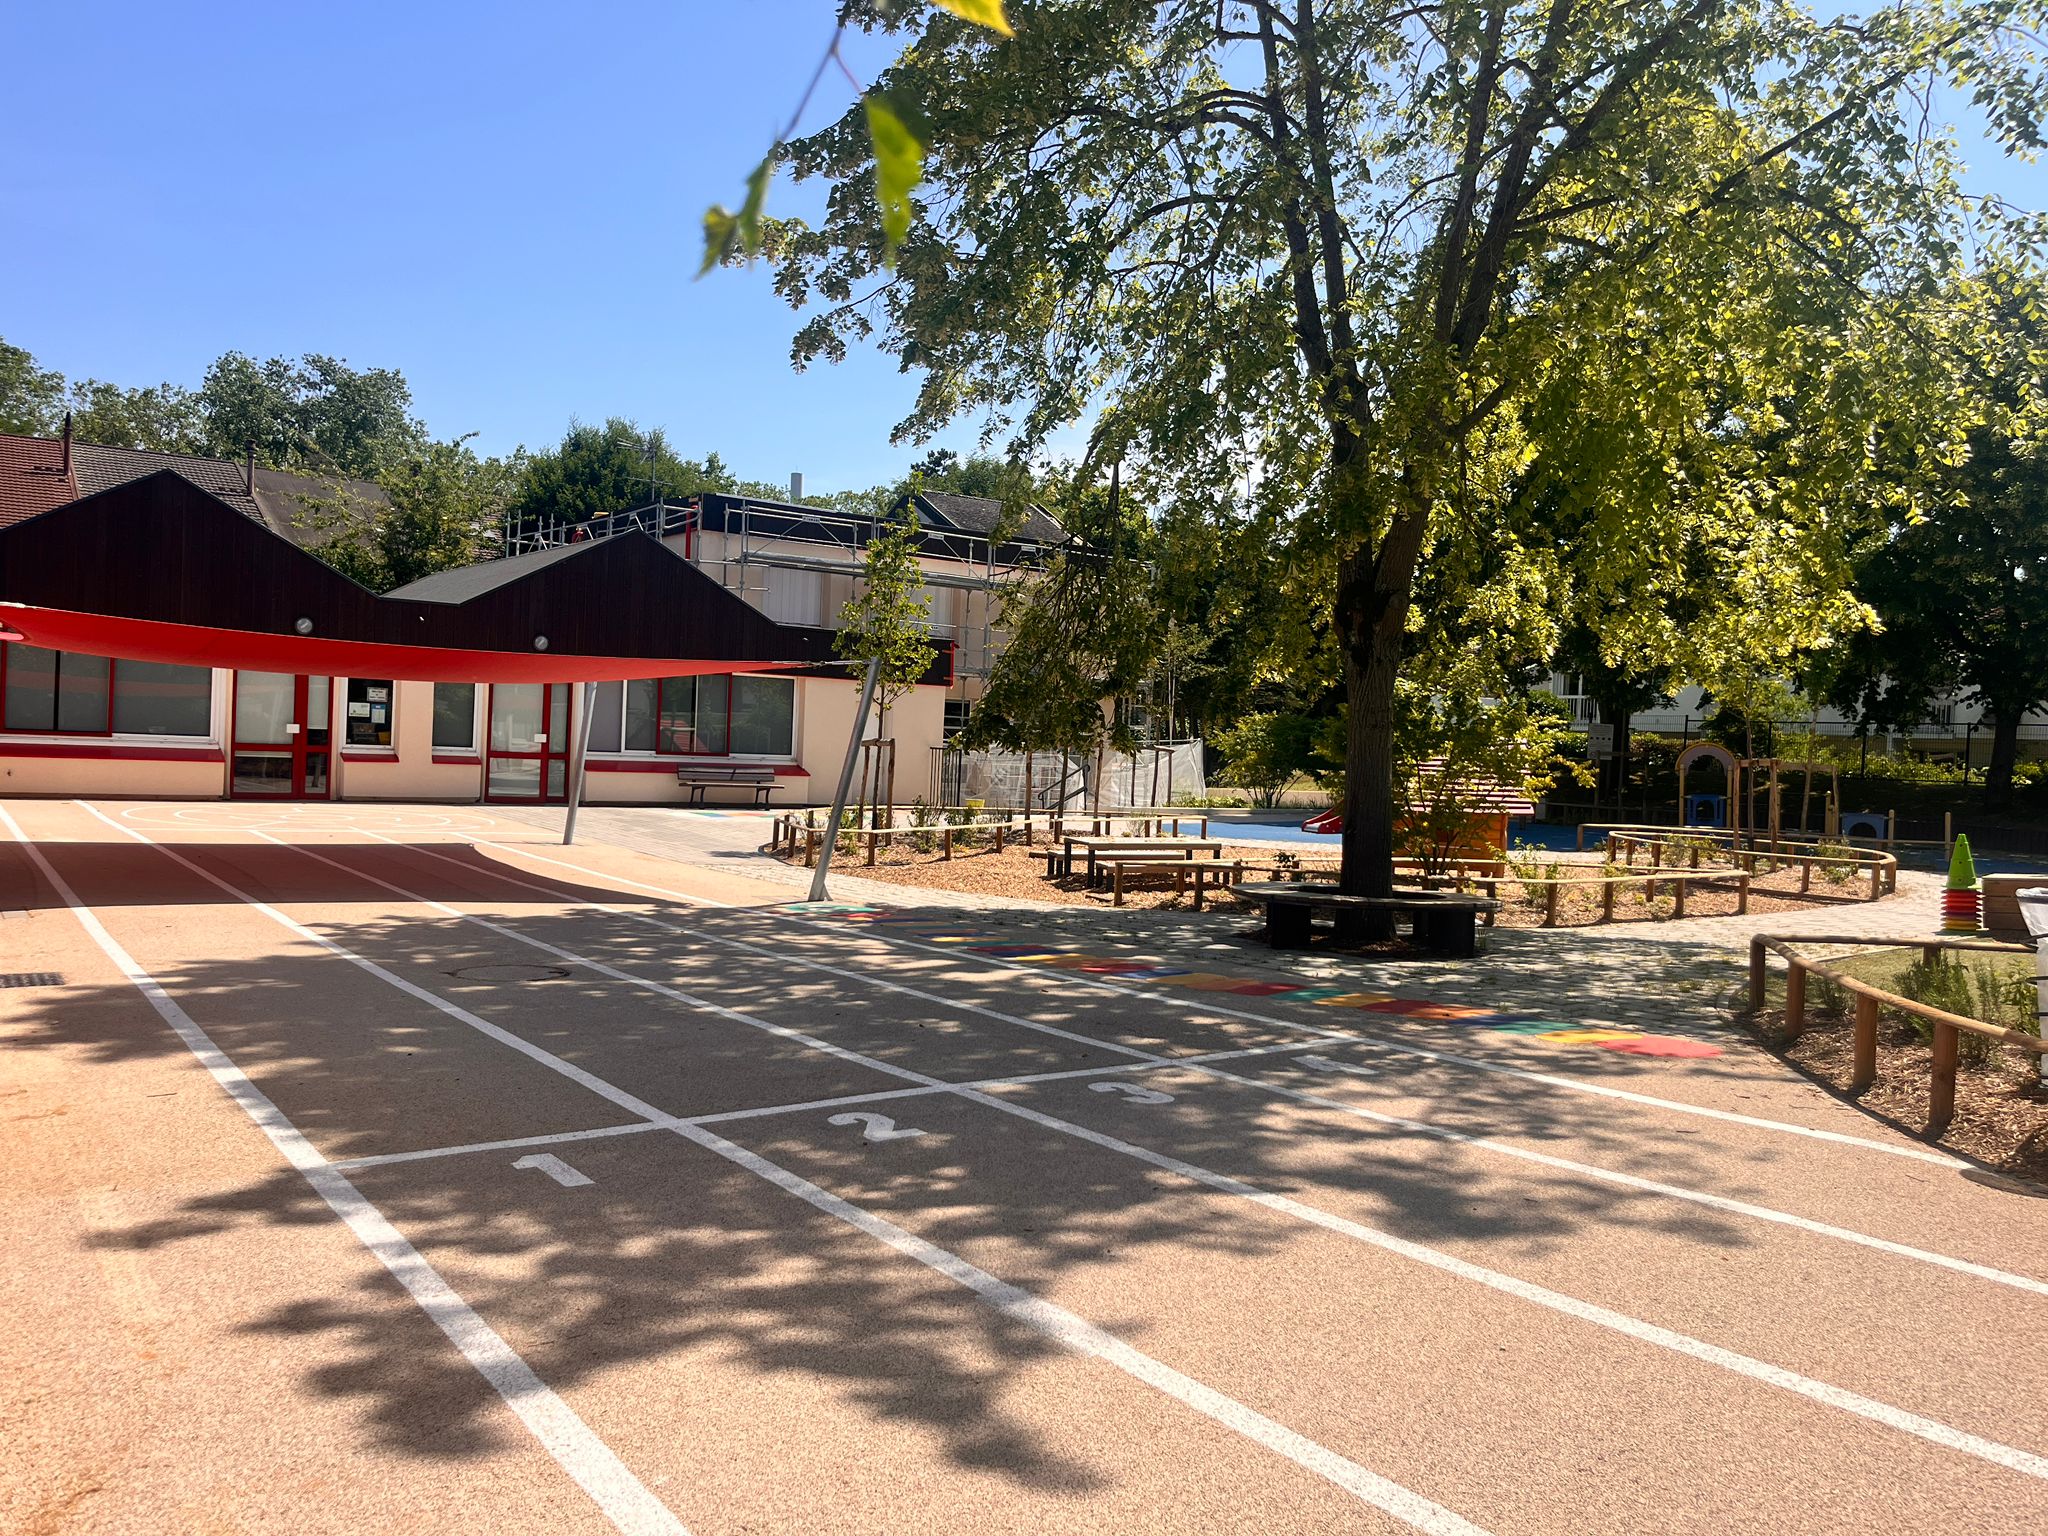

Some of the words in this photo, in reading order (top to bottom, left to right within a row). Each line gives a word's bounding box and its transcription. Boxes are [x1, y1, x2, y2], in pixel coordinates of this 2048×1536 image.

[1087, 1081, 1175, 1104] 3
[827, 1112, 928, 1141] 2
[511, 1153, 596, 1187] 1
